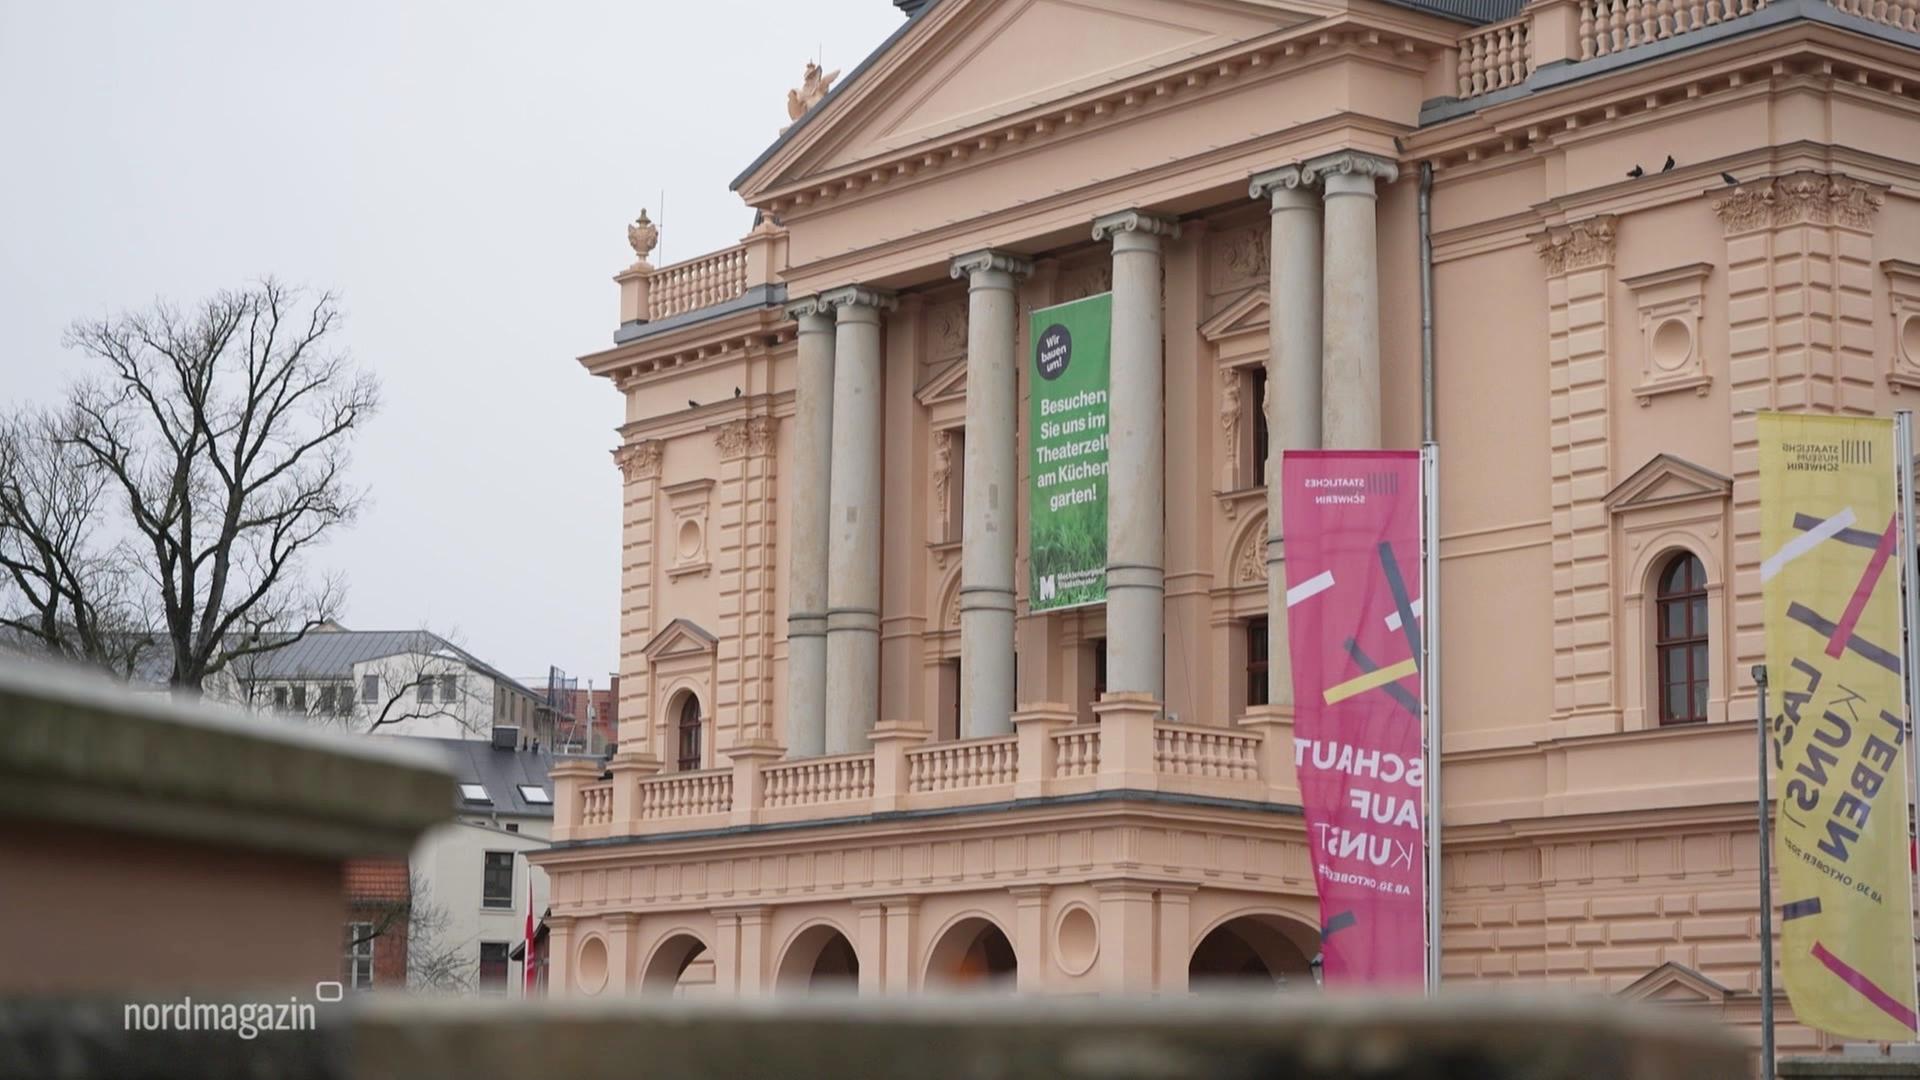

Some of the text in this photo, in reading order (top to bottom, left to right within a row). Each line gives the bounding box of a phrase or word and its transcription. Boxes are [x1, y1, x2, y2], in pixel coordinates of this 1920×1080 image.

[1046, 334, 1060, 348] Wir
[1041, 345, 1067, 363] bauen
[1046, 356, 1062, 372] um!
[1040, 389, 1107, 416] Besuchen
[1040, 411, 1106, 440] Sie uns im
[1037, 471, 1057, 488] am
[1050, 483, 1097, 512] garten!
[1040, 574, 1055, 601] M
